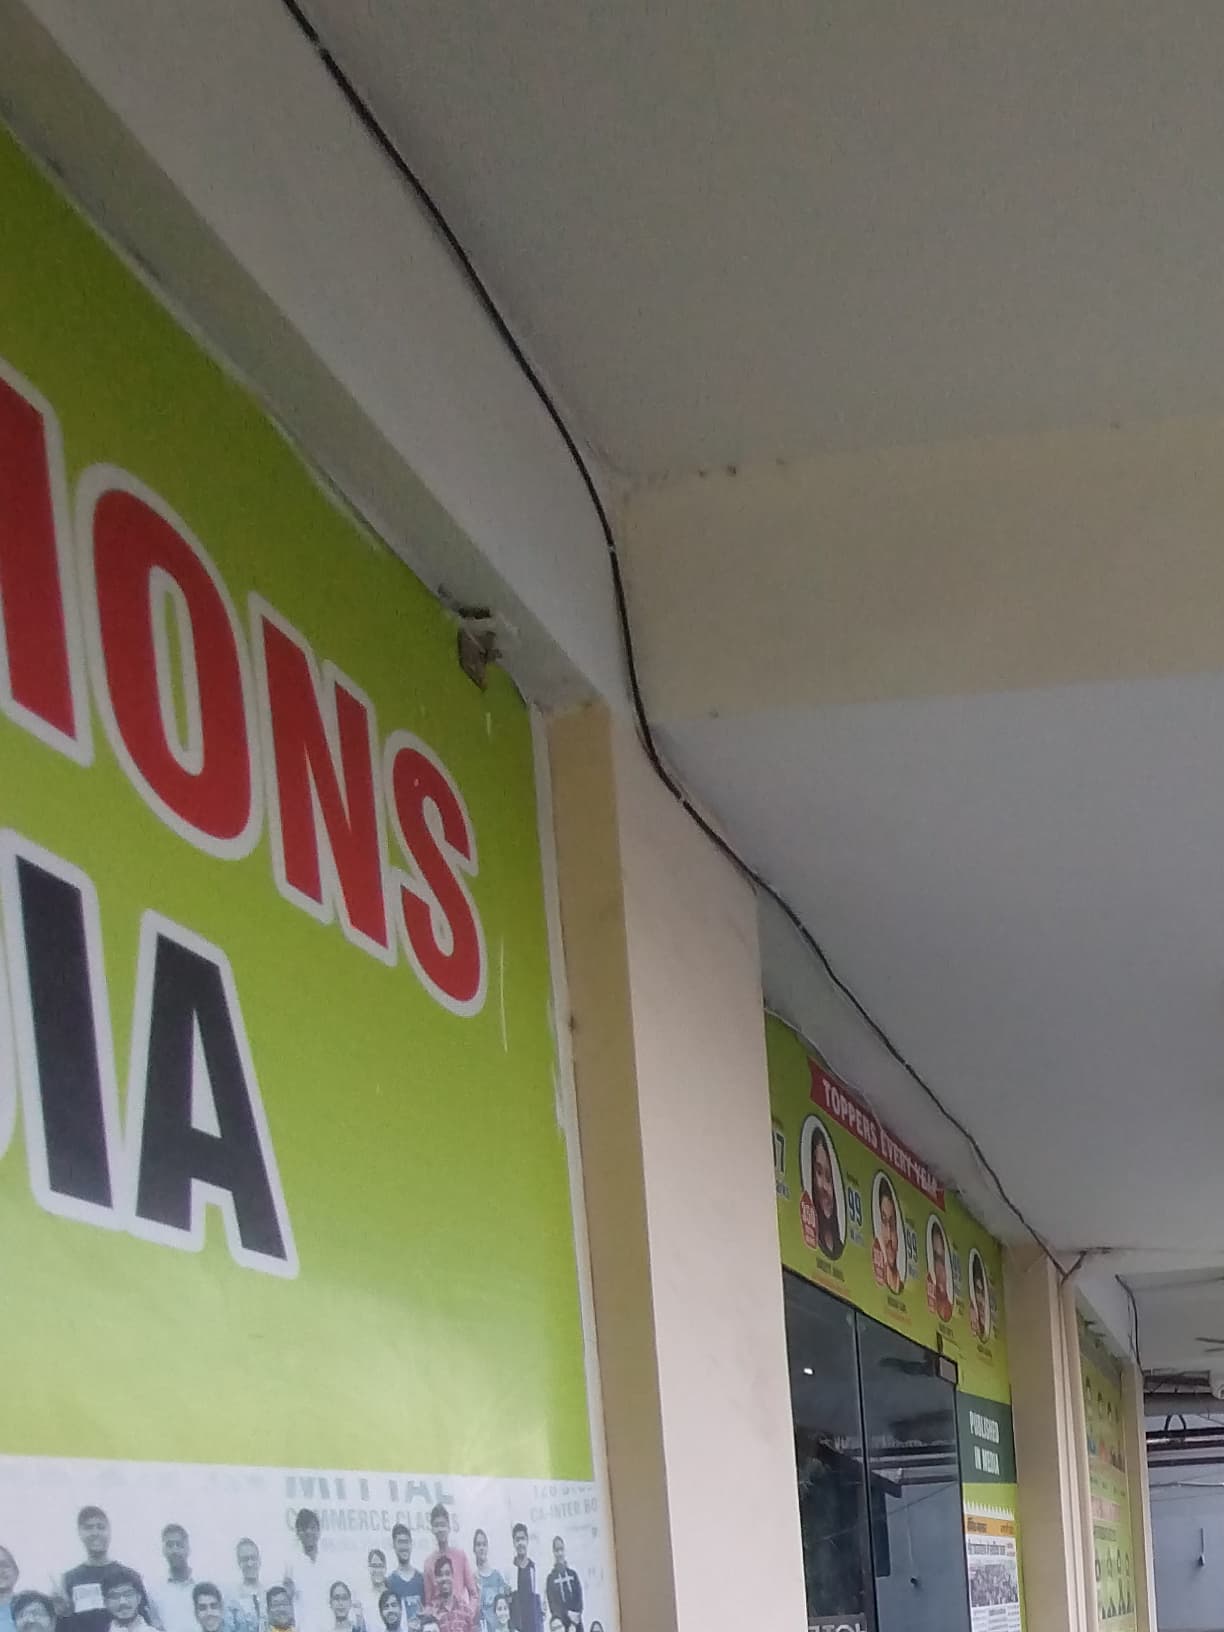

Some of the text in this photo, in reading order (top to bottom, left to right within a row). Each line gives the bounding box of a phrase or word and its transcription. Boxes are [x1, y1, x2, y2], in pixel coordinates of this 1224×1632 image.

[2, 852, 290, 1264] IA
[822, 1078, 878, 1149] TOPPERS
[969, 1411, 1000, 1444] PUBLISHED
[973, 1446, 1000, 1475] IN MEDIA
[286, 1507, 391, 1532] CMMERCE
